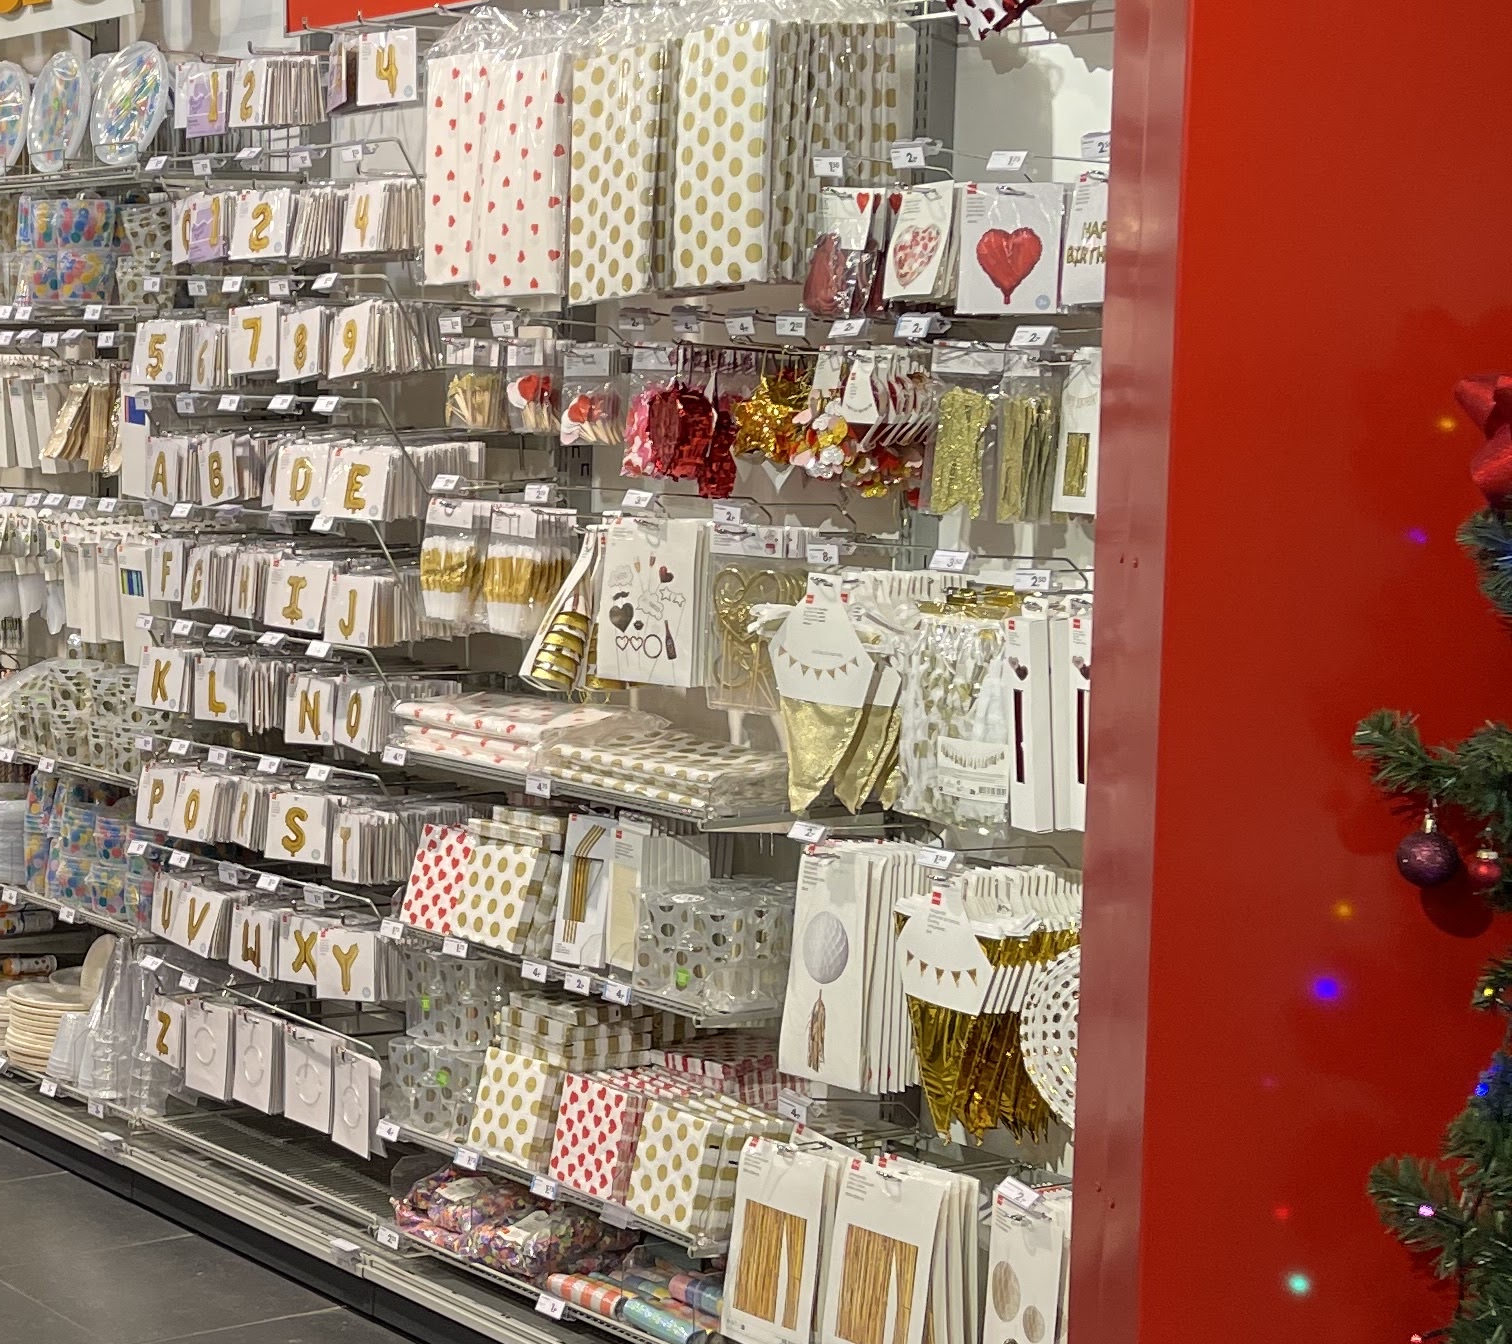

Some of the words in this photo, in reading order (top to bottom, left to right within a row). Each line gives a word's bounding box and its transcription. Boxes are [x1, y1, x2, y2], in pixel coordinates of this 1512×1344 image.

[248, 202, 273, 253] 2
[145, 333, 167, 381] 5
[281, 806, 309, 857] S
